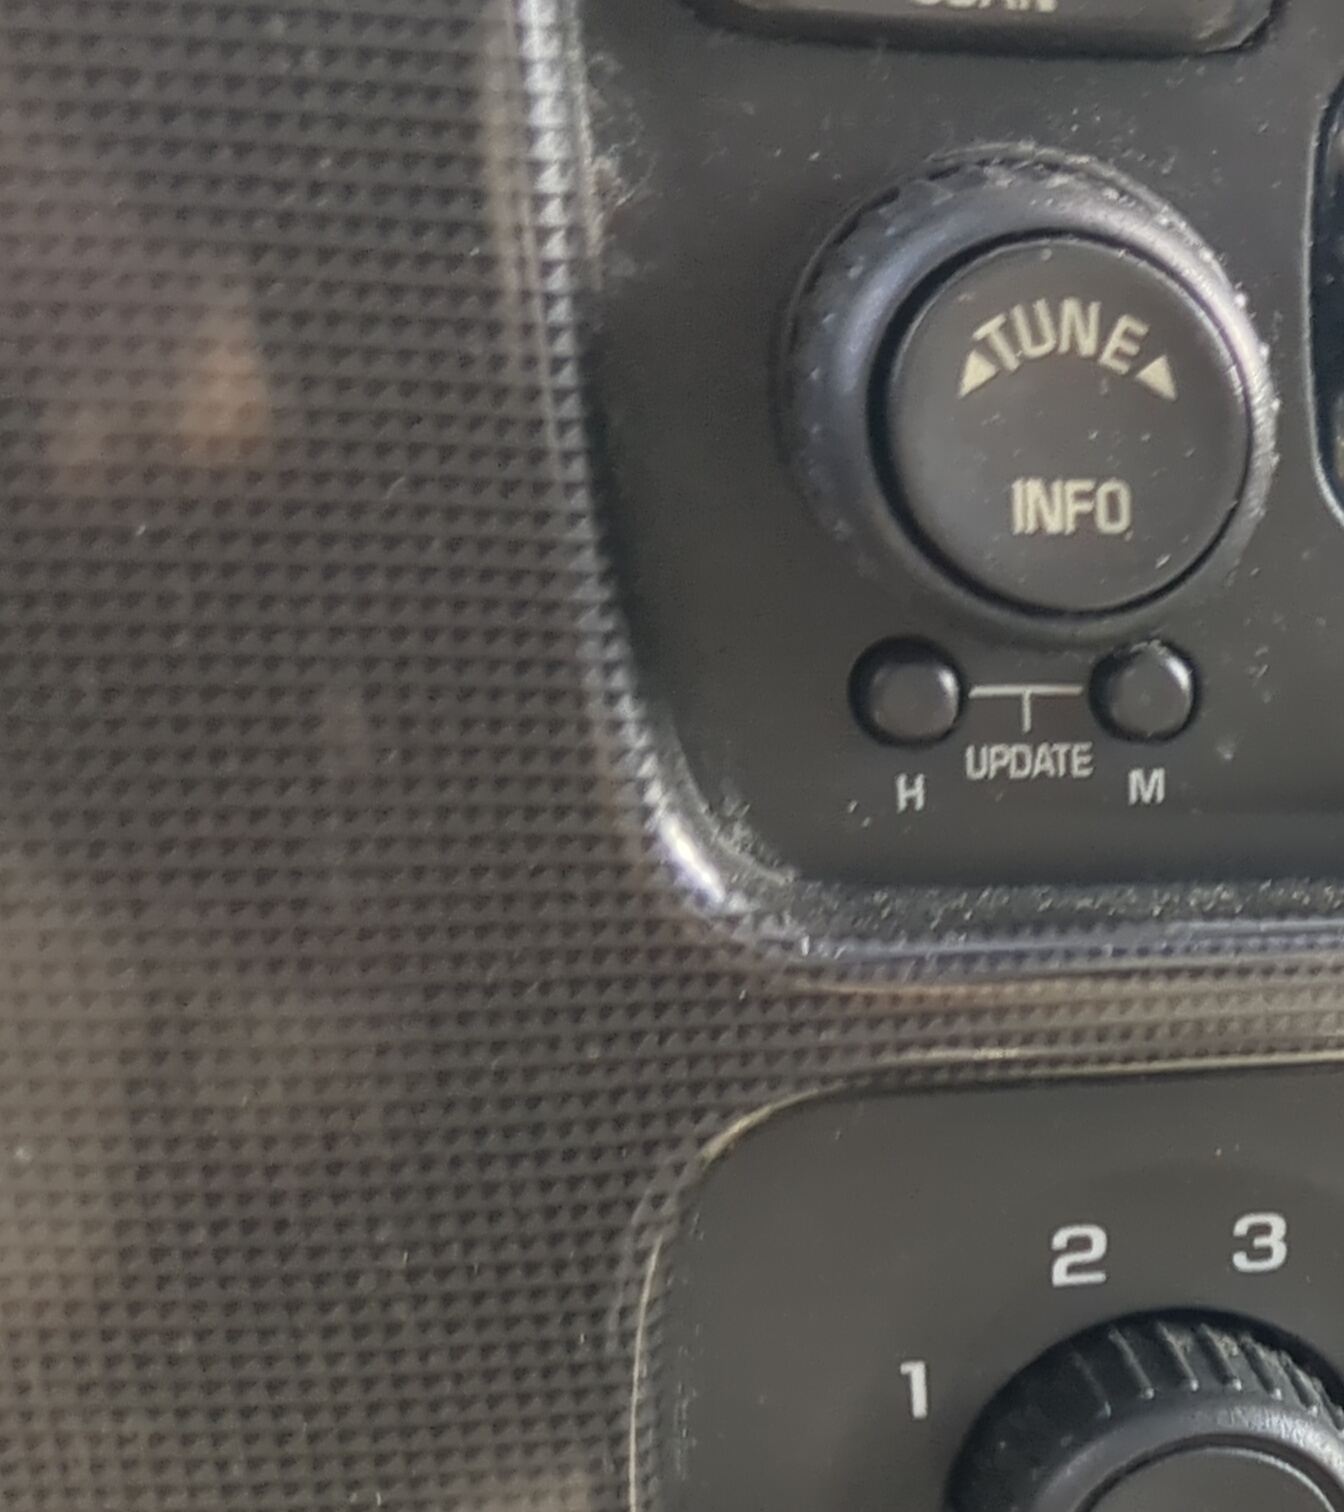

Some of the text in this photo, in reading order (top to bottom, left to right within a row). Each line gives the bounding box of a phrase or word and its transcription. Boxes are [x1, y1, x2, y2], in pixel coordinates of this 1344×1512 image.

[973, 298, 1150, 376] TUNE
[1011, 478, 1132, 536] INFO
[965, 742, 1095, 781] UPDATE
[1127, 767, 1166, 804] M
[896, 774, 926, 811] H
[1051, 1224, 1108, 1287] 2
[1231, 1212, 1288, 1272] 3
[899, 1360, 928, 1419] 1
